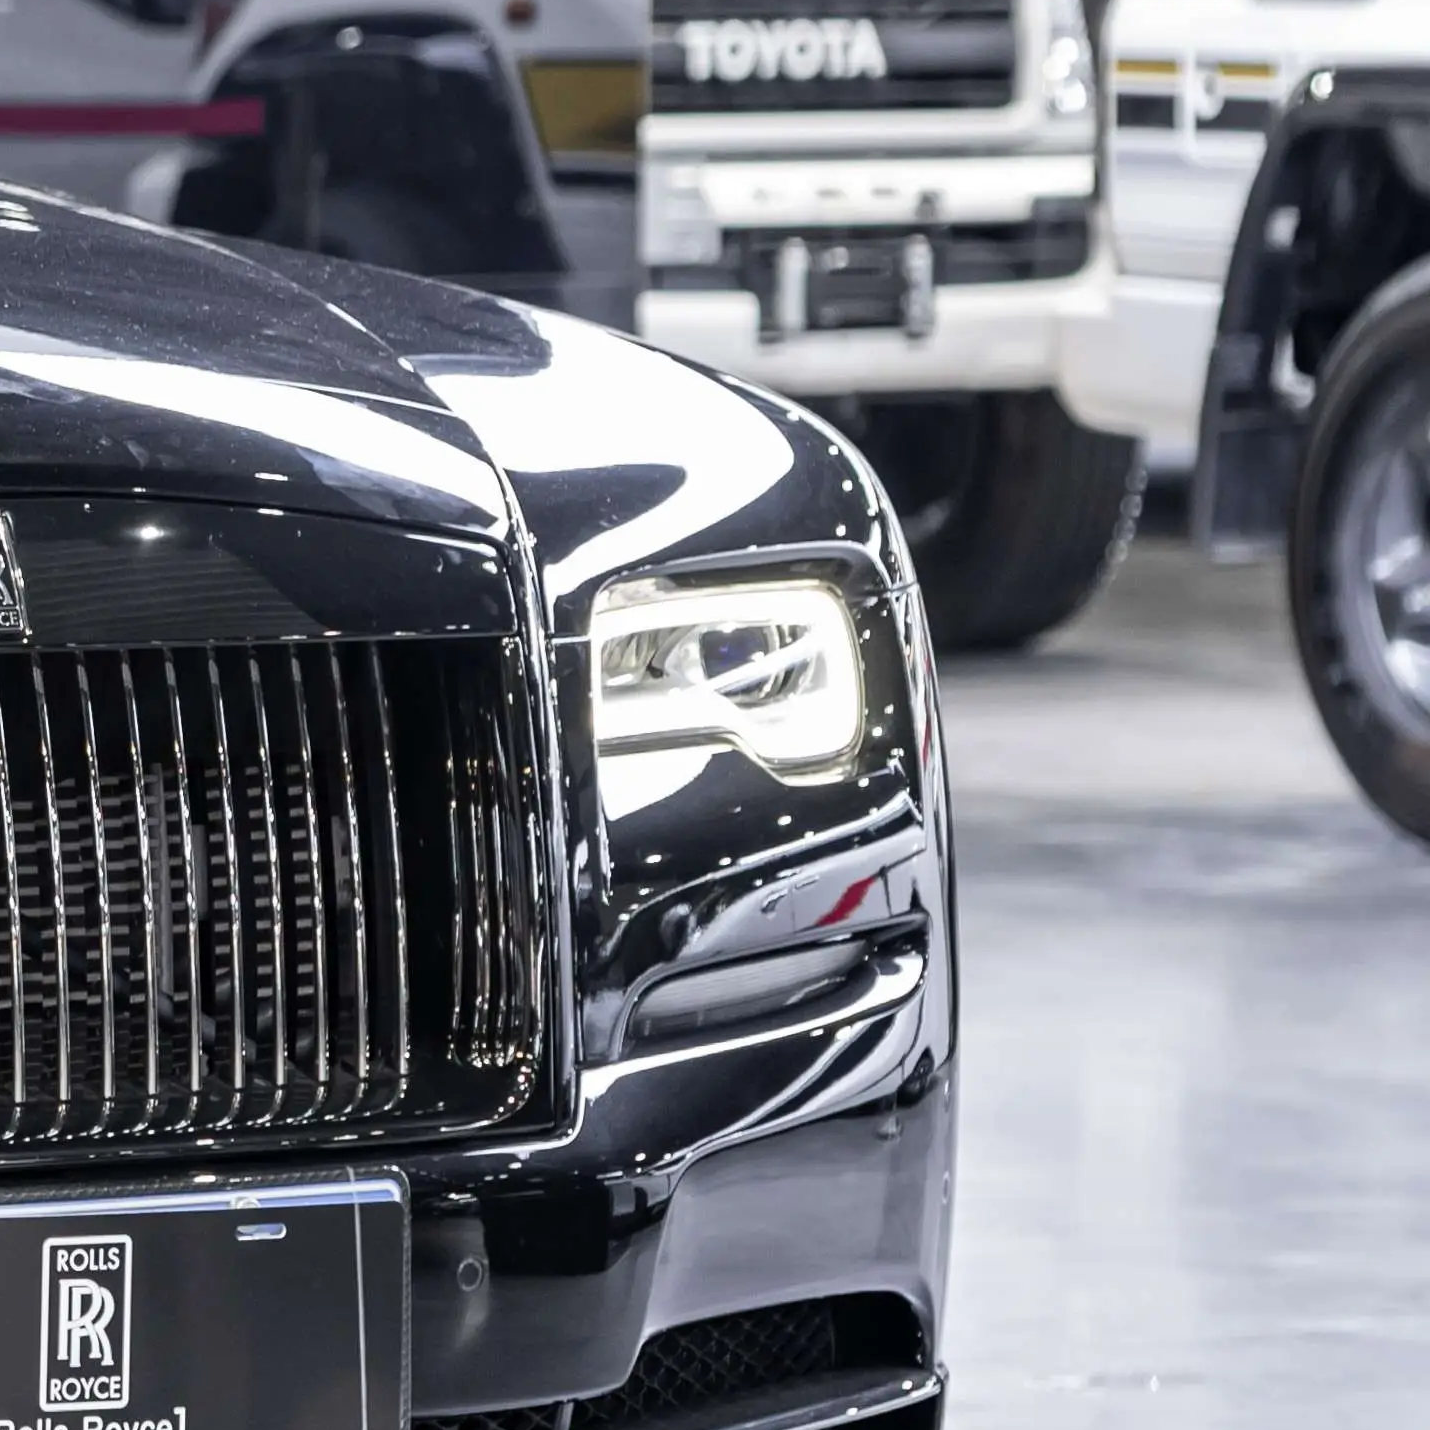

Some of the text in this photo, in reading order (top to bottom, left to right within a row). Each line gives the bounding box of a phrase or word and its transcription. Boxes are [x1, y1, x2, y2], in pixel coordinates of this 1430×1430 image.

[678, 17, 886, 82] TOYOTA
[56, 1247, 121, 1273] ROLLS
[49, 1375, 122, 1402] ROYCE
